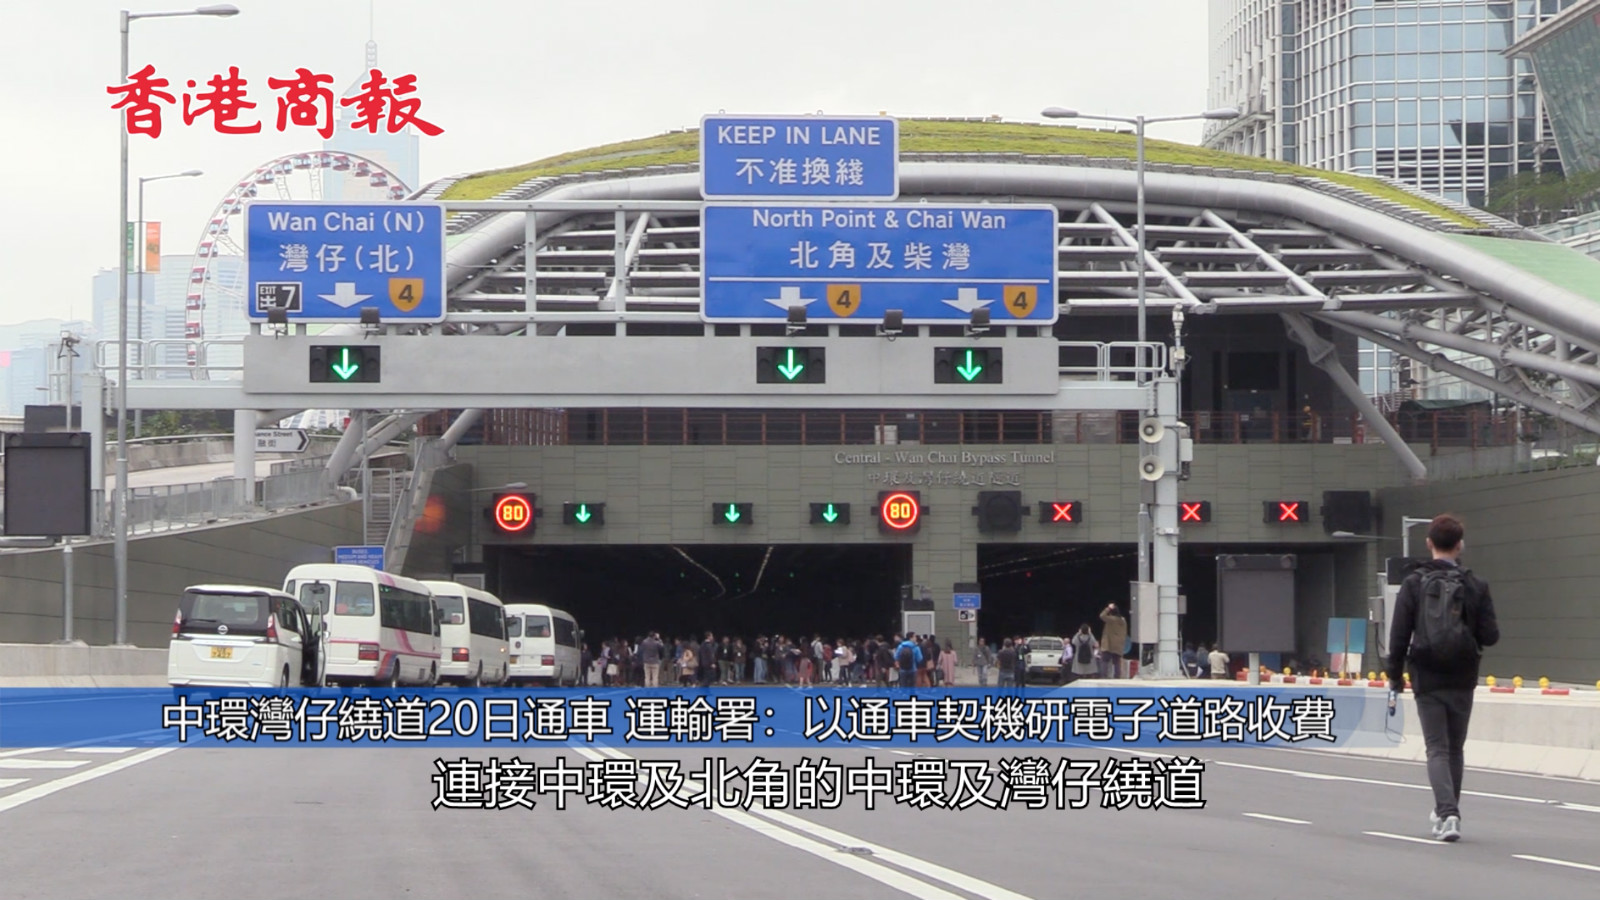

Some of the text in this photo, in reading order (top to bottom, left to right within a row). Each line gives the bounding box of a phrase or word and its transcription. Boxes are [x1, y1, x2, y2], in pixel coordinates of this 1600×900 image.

[718, 125, 881, 145] KEEP IN LANE
[735, 157, 864, 186] 不准換綫
[268, 211, 425, 233] Wan Chai (N)
[752, 209, 1006, 229] North Point & Chai Wan
[279, 243, 415, 273] 灣仔(北)
[790, 241, 971, 270] 北角及柴灣
[260, 286, 296, 308] EXIT 7
[398, 284, 414, 303] 4
[836, 290, 852, 309] 4
[1013, 291, 1028, 310] 4
[834, 452, 881, 464] Central
[895, 452, 924, 464] Wan
[927, 451, 957, 464] Chai
[961, 452, 1006, 467] Bypass
[1012, 452, 1055, 464] Tunnel
[503, 505, 523, 521] 80
[890, 502, 910, 519] 80
